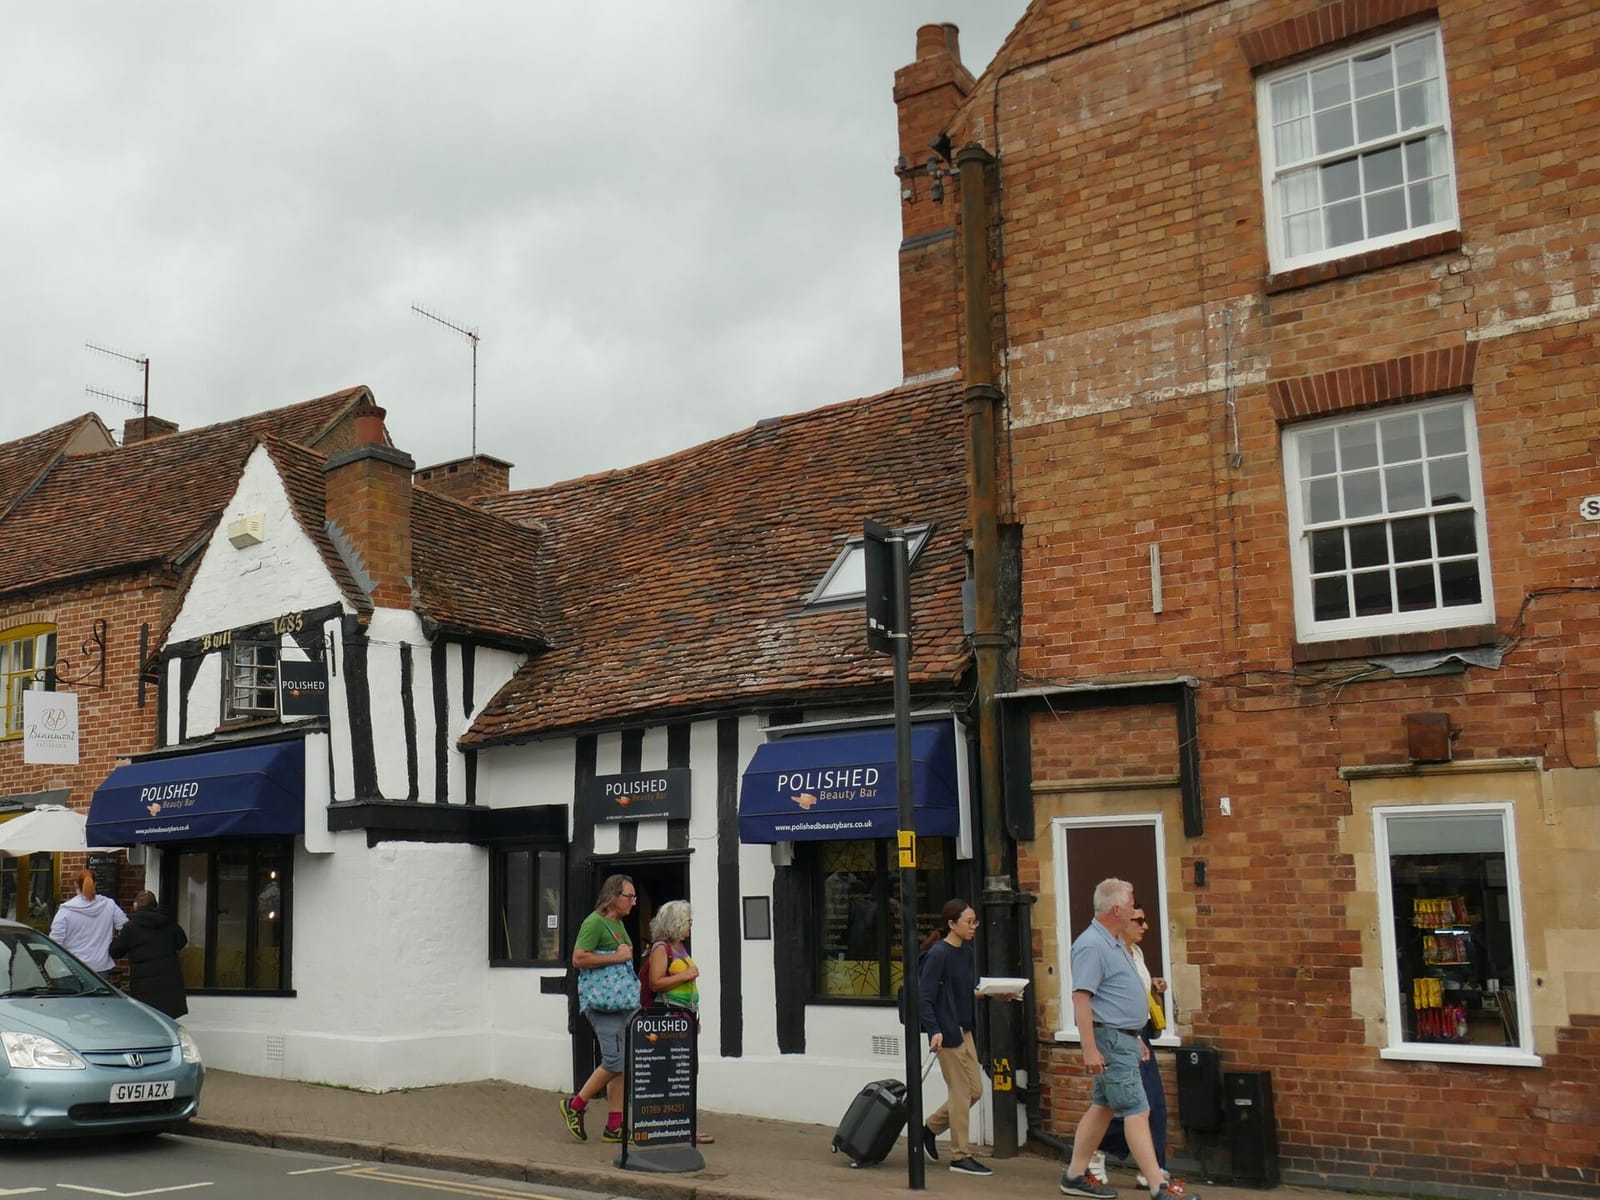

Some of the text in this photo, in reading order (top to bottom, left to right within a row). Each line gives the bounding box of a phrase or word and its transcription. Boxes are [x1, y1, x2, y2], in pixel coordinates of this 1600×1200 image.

[272, 612, 304, 635] 1485
[282, 680, 325, 690] POLISHED
[777, 768, 879, 792] POLISHED
[140, 782, 199, 802] POLISHED
[606, 779, 667, 796] POLISHED
[819, 788, 877, 801] Beauty Bar
[162, 798, 196, 809] Beauty Bar
[775, 820, 873, 832] www.polishedbeautybars.co.uk
[637, 1020, 688, 1032] POLISHED
[1190, 1052, 1199, 1065] 9
[118, 1083, 169, 1100] GV51 AZX
